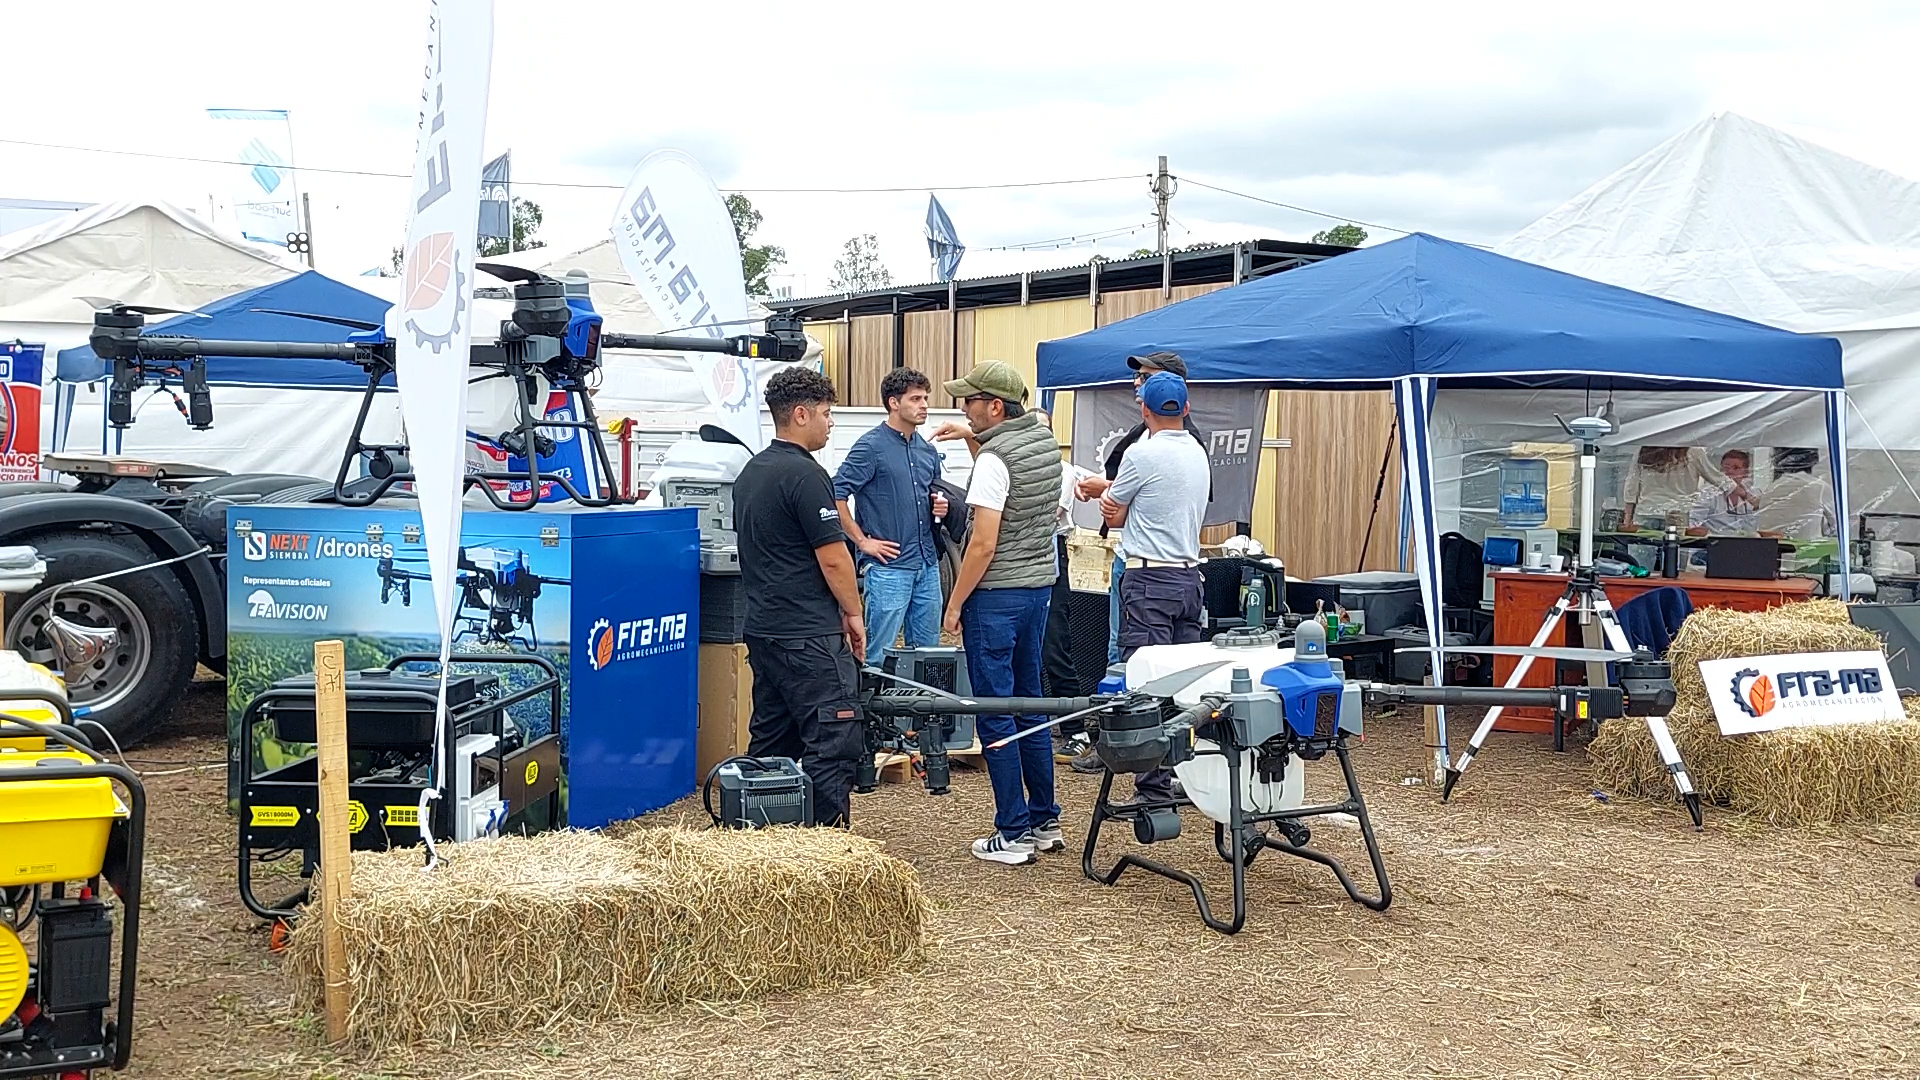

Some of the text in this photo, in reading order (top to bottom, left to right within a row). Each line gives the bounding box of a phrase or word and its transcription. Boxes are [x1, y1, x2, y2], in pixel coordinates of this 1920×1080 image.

[269, 534, 310, 550] NEXT
[269, 551, 309, 560] SIEMBRA
[243, 576, 331, 587] Representantes oficiales
[617, 641, 685, 661] AGROMECANIZACIÓN
[323, 655, 336, 670] C
[1782, 696, 1883, 709] AGROMECANIZACIÓN
